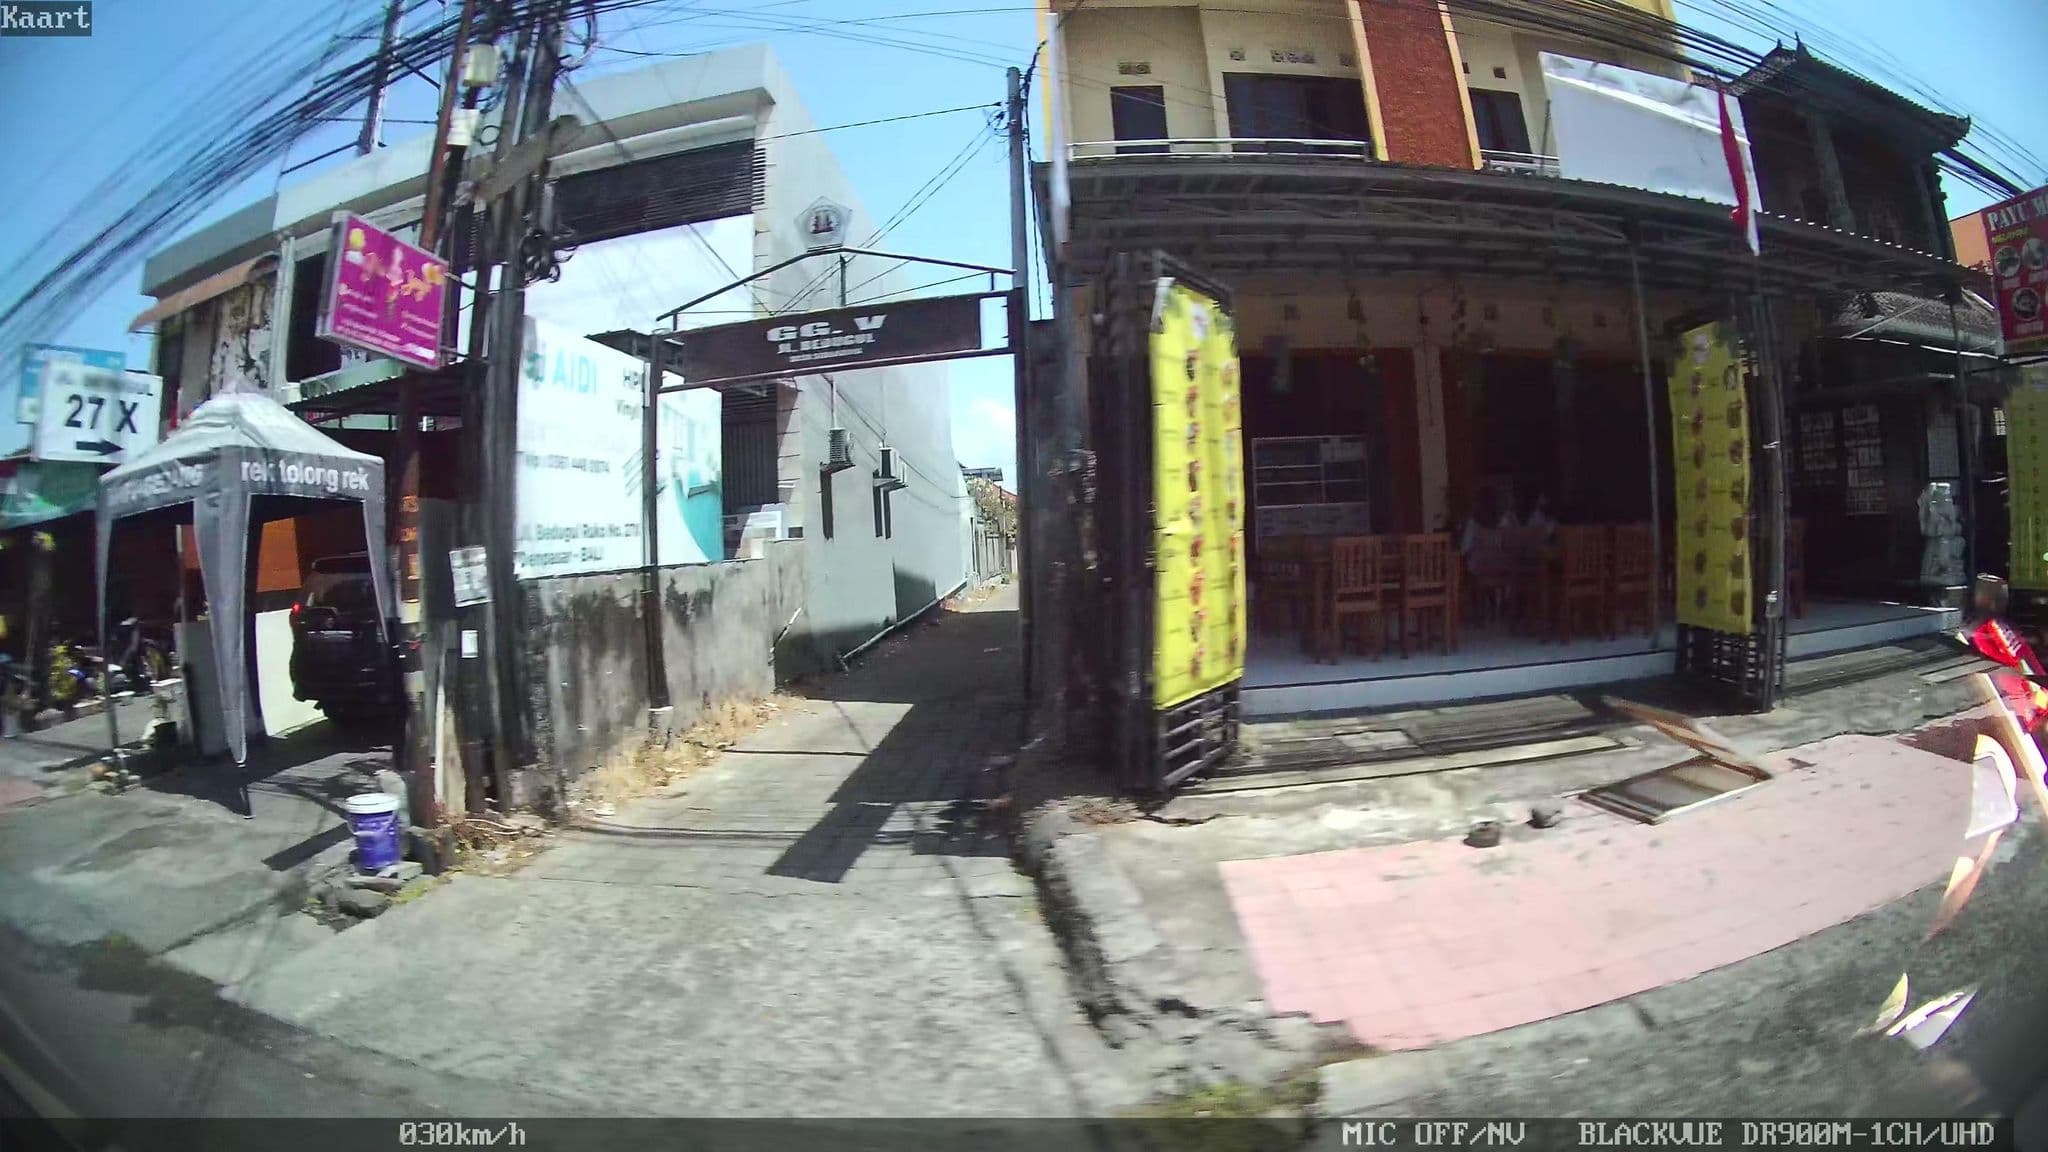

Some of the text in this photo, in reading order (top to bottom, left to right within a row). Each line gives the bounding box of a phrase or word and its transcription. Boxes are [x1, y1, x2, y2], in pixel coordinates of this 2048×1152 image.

[853, 314, 888, 331] V
[65, 393, 139, 434] 27 X
[240, 459, 370, 492] rek tolong rek
